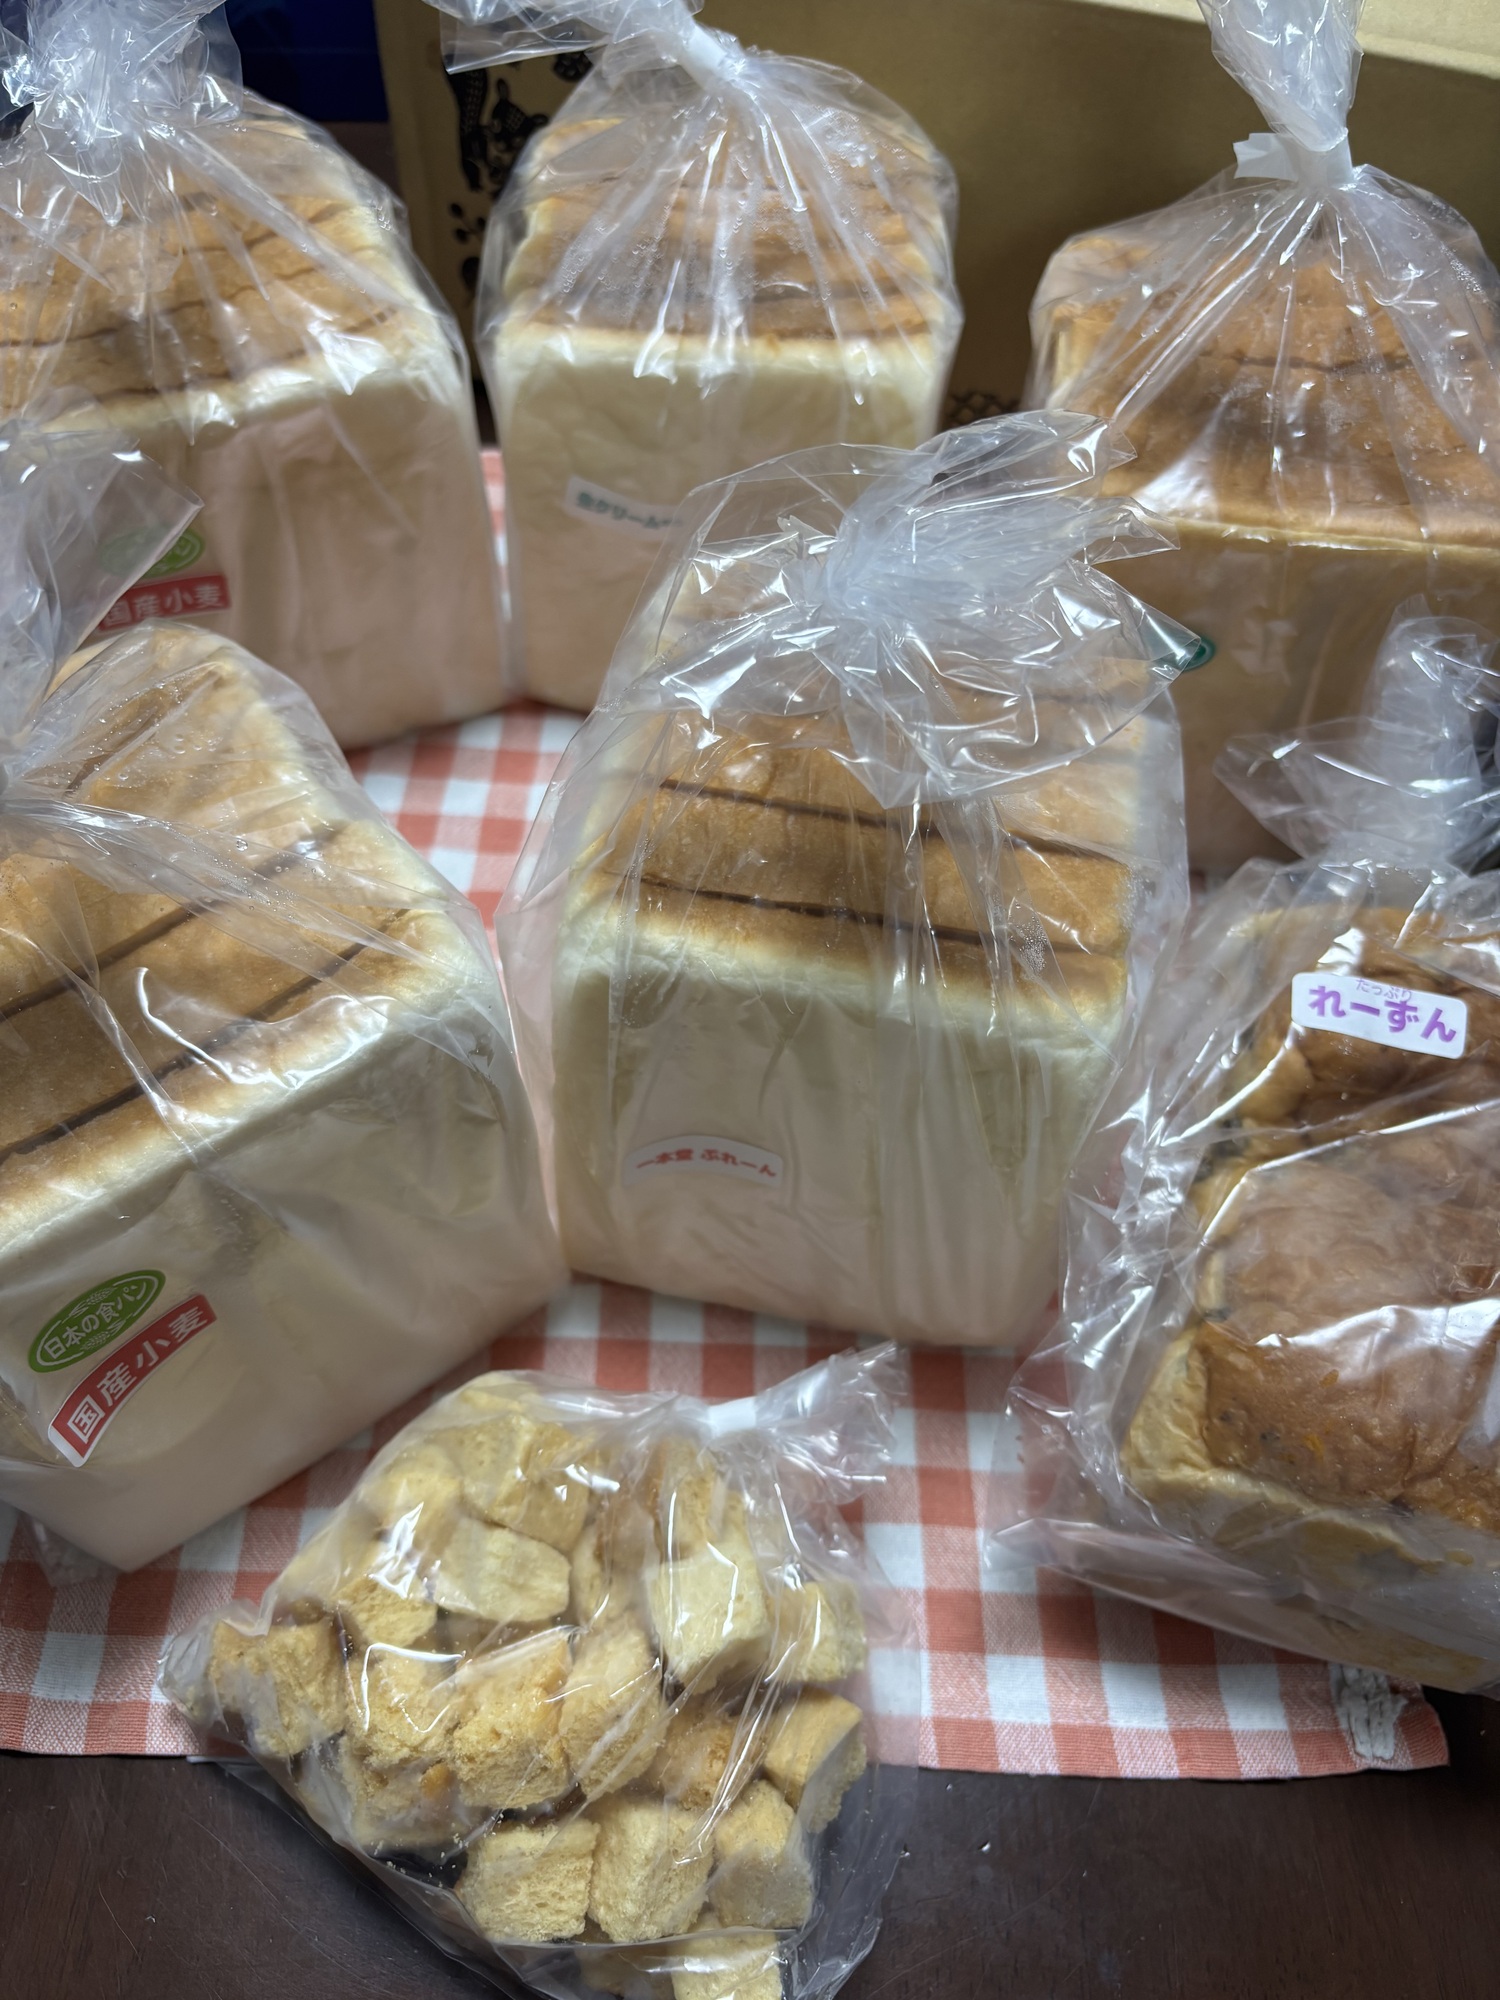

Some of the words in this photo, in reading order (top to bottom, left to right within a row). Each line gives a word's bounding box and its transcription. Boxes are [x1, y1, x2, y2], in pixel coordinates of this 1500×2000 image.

[105, 584, 224, 626] 国産小麦
[1308, 985, 1457, 1043] れーずん
[1355, 977, 1413, 1001] たっぷり
[701, 1149, 776, 1177] ぷれーん
[43, 1281, 147, 1360] 日本の食パン
[67, 1306, 208, 1444] 国産小麦
